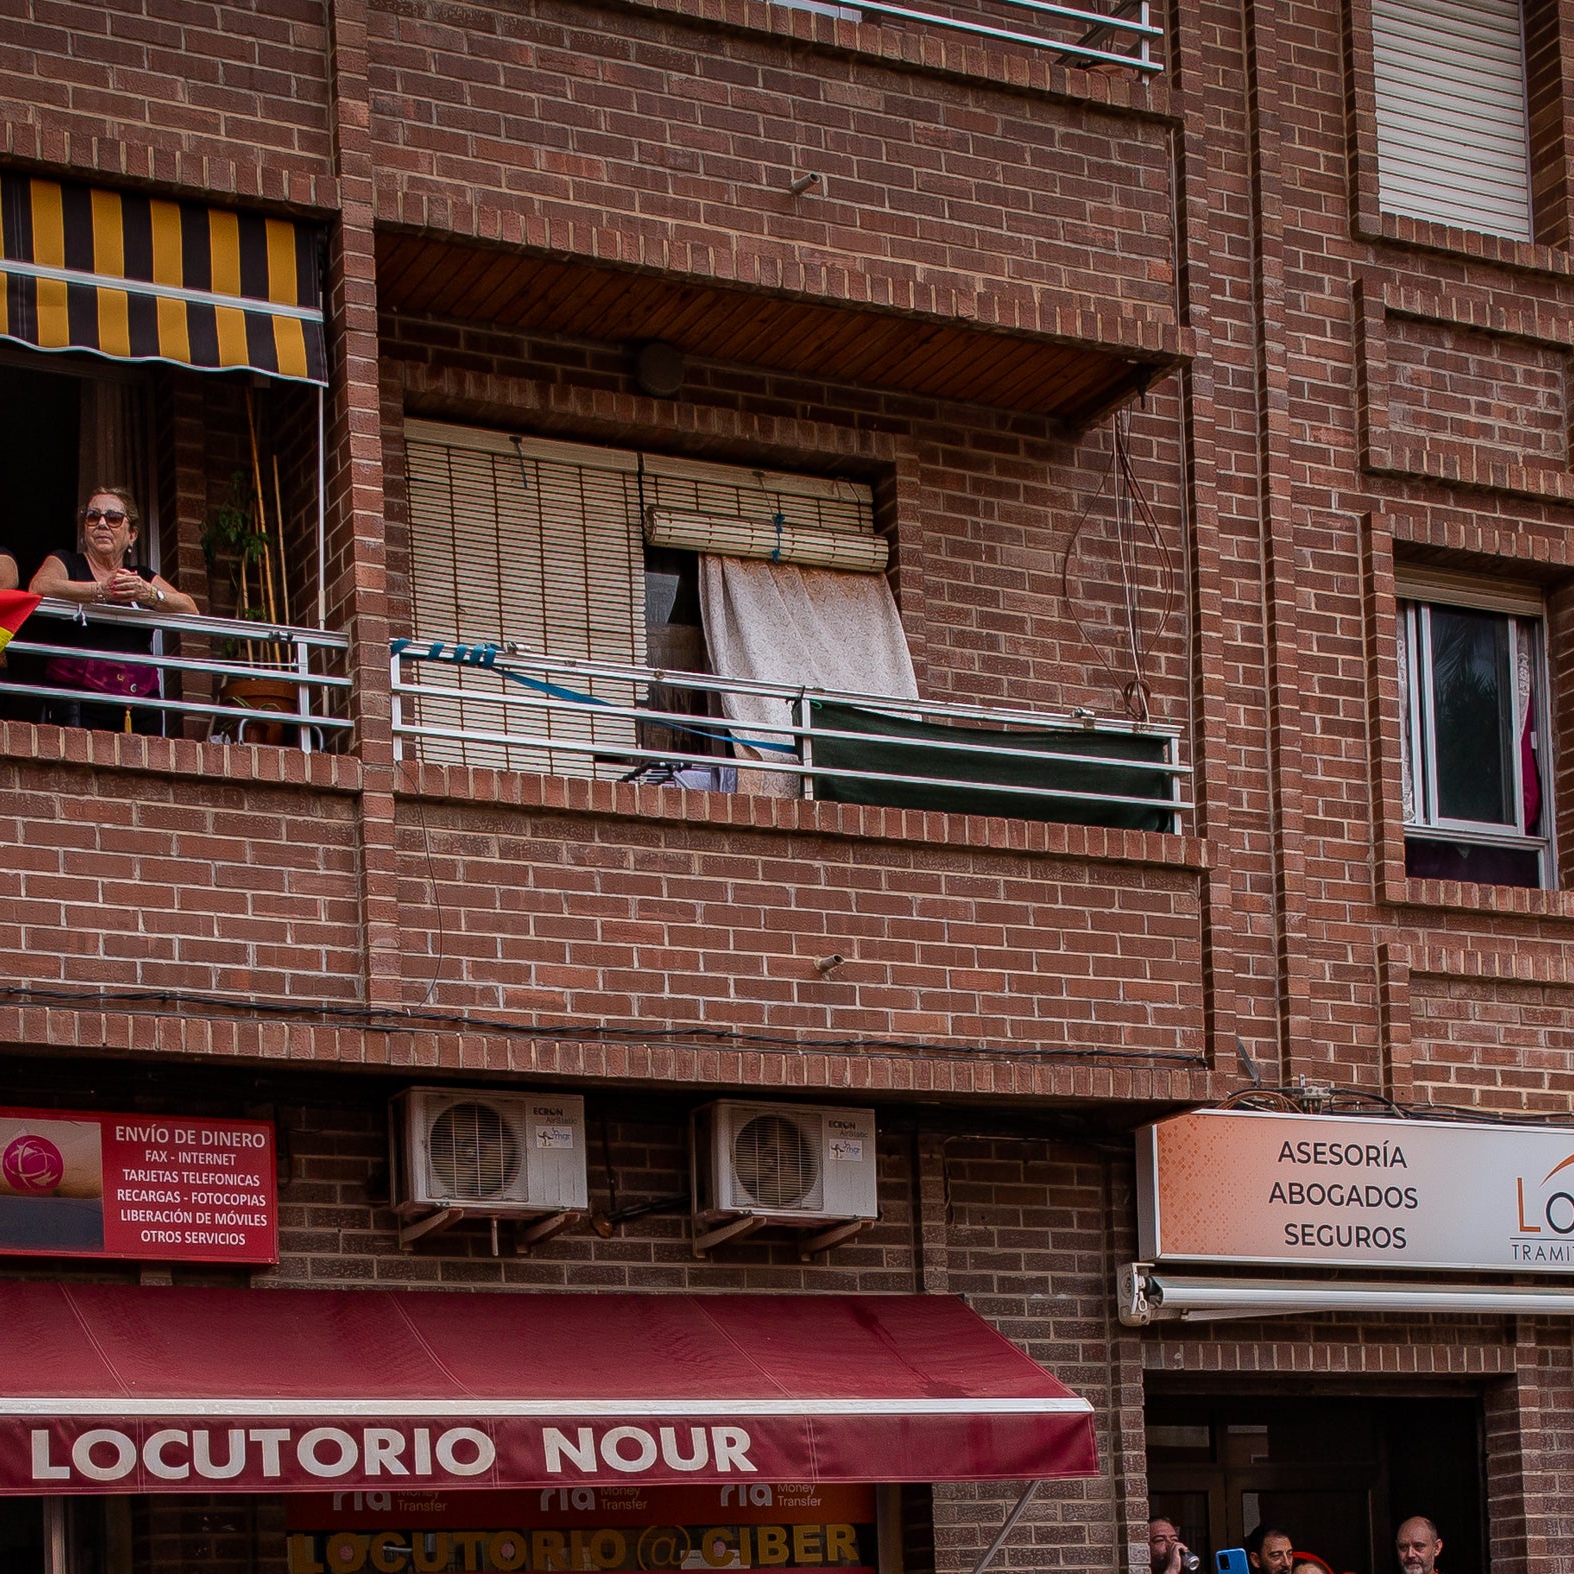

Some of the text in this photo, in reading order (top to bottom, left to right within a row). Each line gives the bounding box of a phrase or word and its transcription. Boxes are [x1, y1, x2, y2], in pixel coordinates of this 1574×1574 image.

[116, 1124, 266, 1148] ENVÍO DE DINERO
[145, 1150, 168, 1163] FAX
[178, 1152, 236, 1166] INTERNET
[1277, 1140, 1408, 1169] ASESORÍA
[122, 1169, 260, 1187] TARJETAS TELEFONICAS
[117, 1189, 181, 1203] RECARGAS
[191, 1192, 266, 1207] FOTOCOPIAS
[1269, 1181, 1419, 1210] ABOGADOS
[120, 1208, 267, 1227] LIBERACIÓN DE MÓVILES
[141, 1230, 246, 1245] OTROS SERVICIOS
[1284, 1223, 1407, 1250] SEGUROS
[31, 1424, 758, 1480] LOCUTORIO NOUR
[397, 1500, 448, 1513] Transfer
[600, 1498, 648, 1511] Transfer
[777, 1494, 822, 1508] Transfer
[291, 1524, 859, 1574] LOCUTORIO @ CIBER
